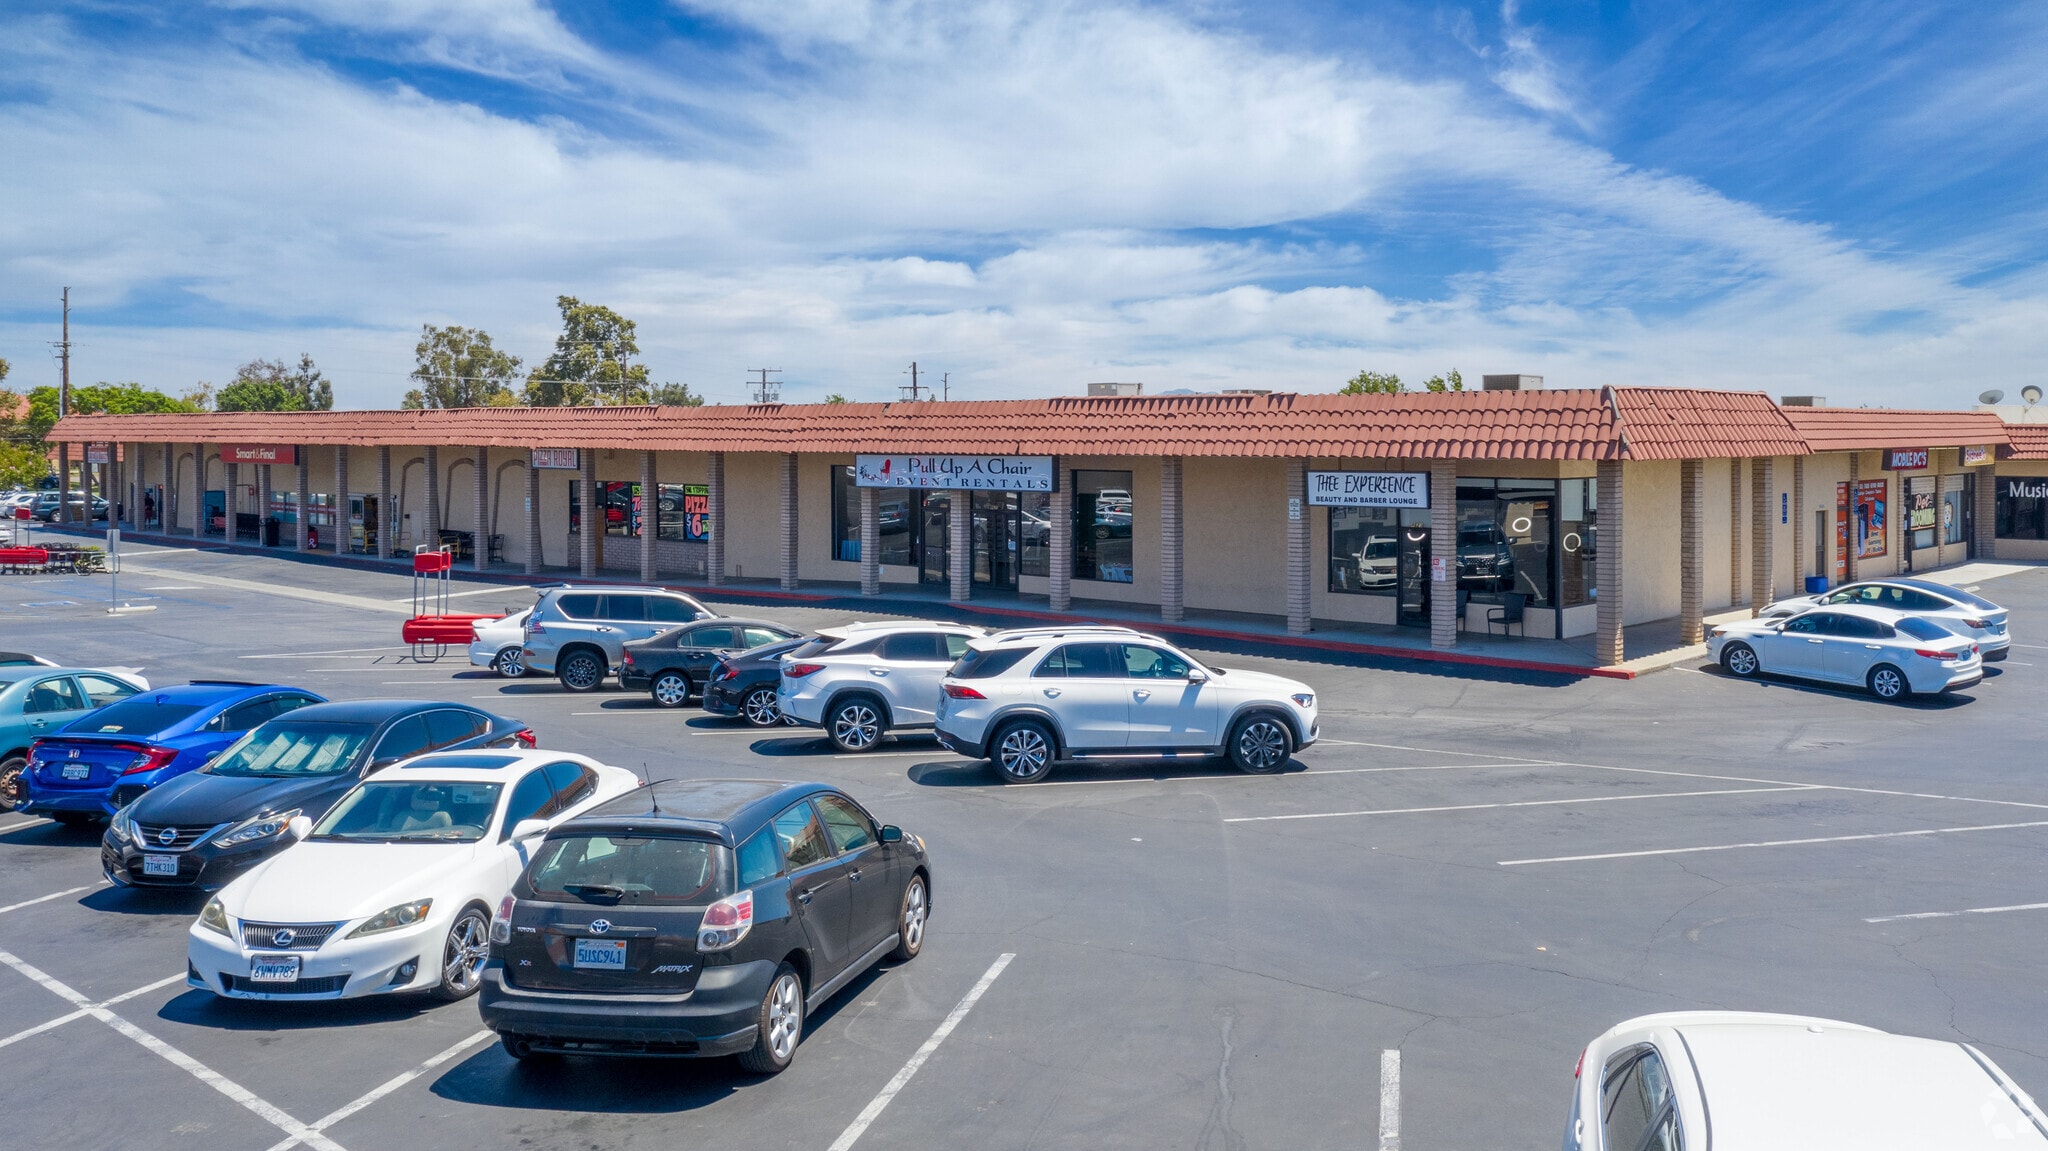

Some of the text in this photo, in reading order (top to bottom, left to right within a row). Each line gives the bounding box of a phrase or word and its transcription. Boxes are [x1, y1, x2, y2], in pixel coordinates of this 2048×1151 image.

[533, 450, 576, 467] PIZZA ROYAL
[1891, 451, 1927, 467] MOBILE PC'S
[908, 457, 1032, 479] Pull Up A Chair
[896, 477, 1048, 489] EVENT RENTALS
[1315, 474, 1417, 494] THEE EXPERIENCE
[2009, 481, 2048, 498] Musi
[1316, 495, 1342, 503] BEAUTY
[1360, 496, 1387, 504] BARBER
[1389, 497, 1418, 505] LOUNGE
[1916, 494, 1933, 510] Pet
[145, 862, 175, 872] 7THK310
[578, 949, 623, 964] 5USC941
[651, 965, 693, 974] MATRIX
